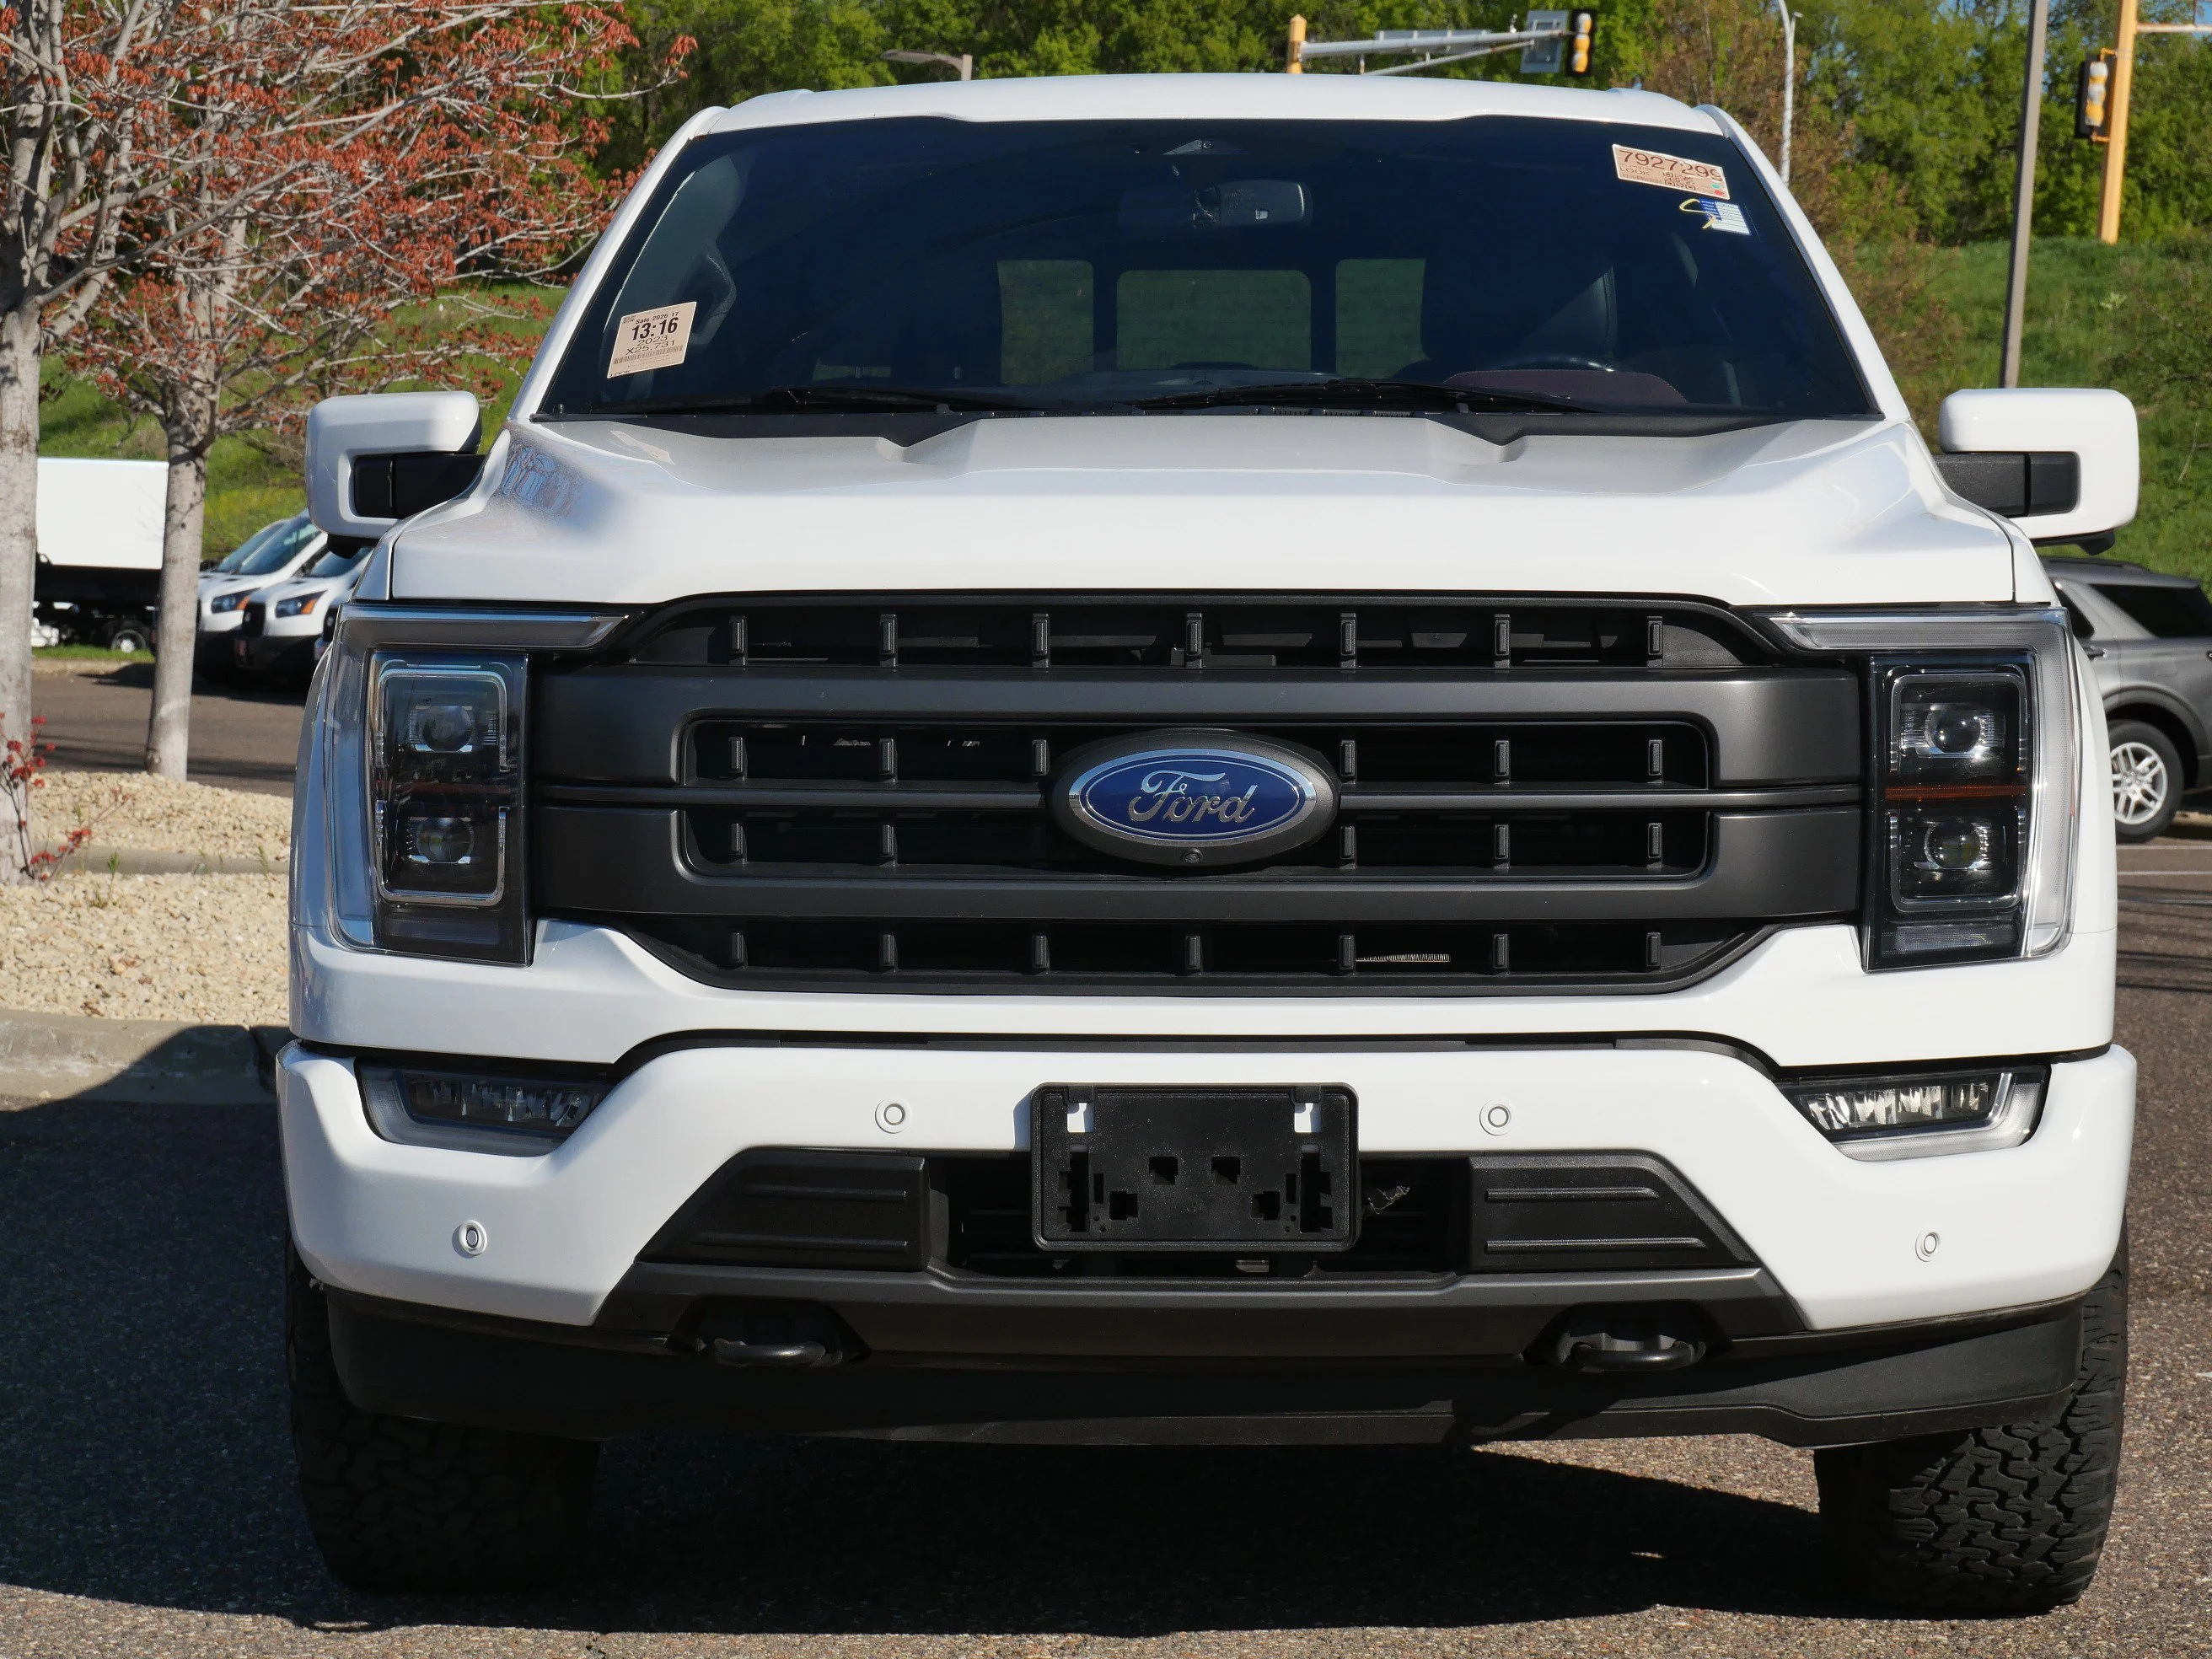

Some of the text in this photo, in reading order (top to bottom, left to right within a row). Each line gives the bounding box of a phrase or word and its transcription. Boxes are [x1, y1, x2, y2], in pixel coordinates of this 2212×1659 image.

[1619, 149, 1723, 182] 7927299
[631, 317, 679, 341] 13:16
[637, 335, 668, 346] 2023
[1128, 770, 1259, 823] Ford
